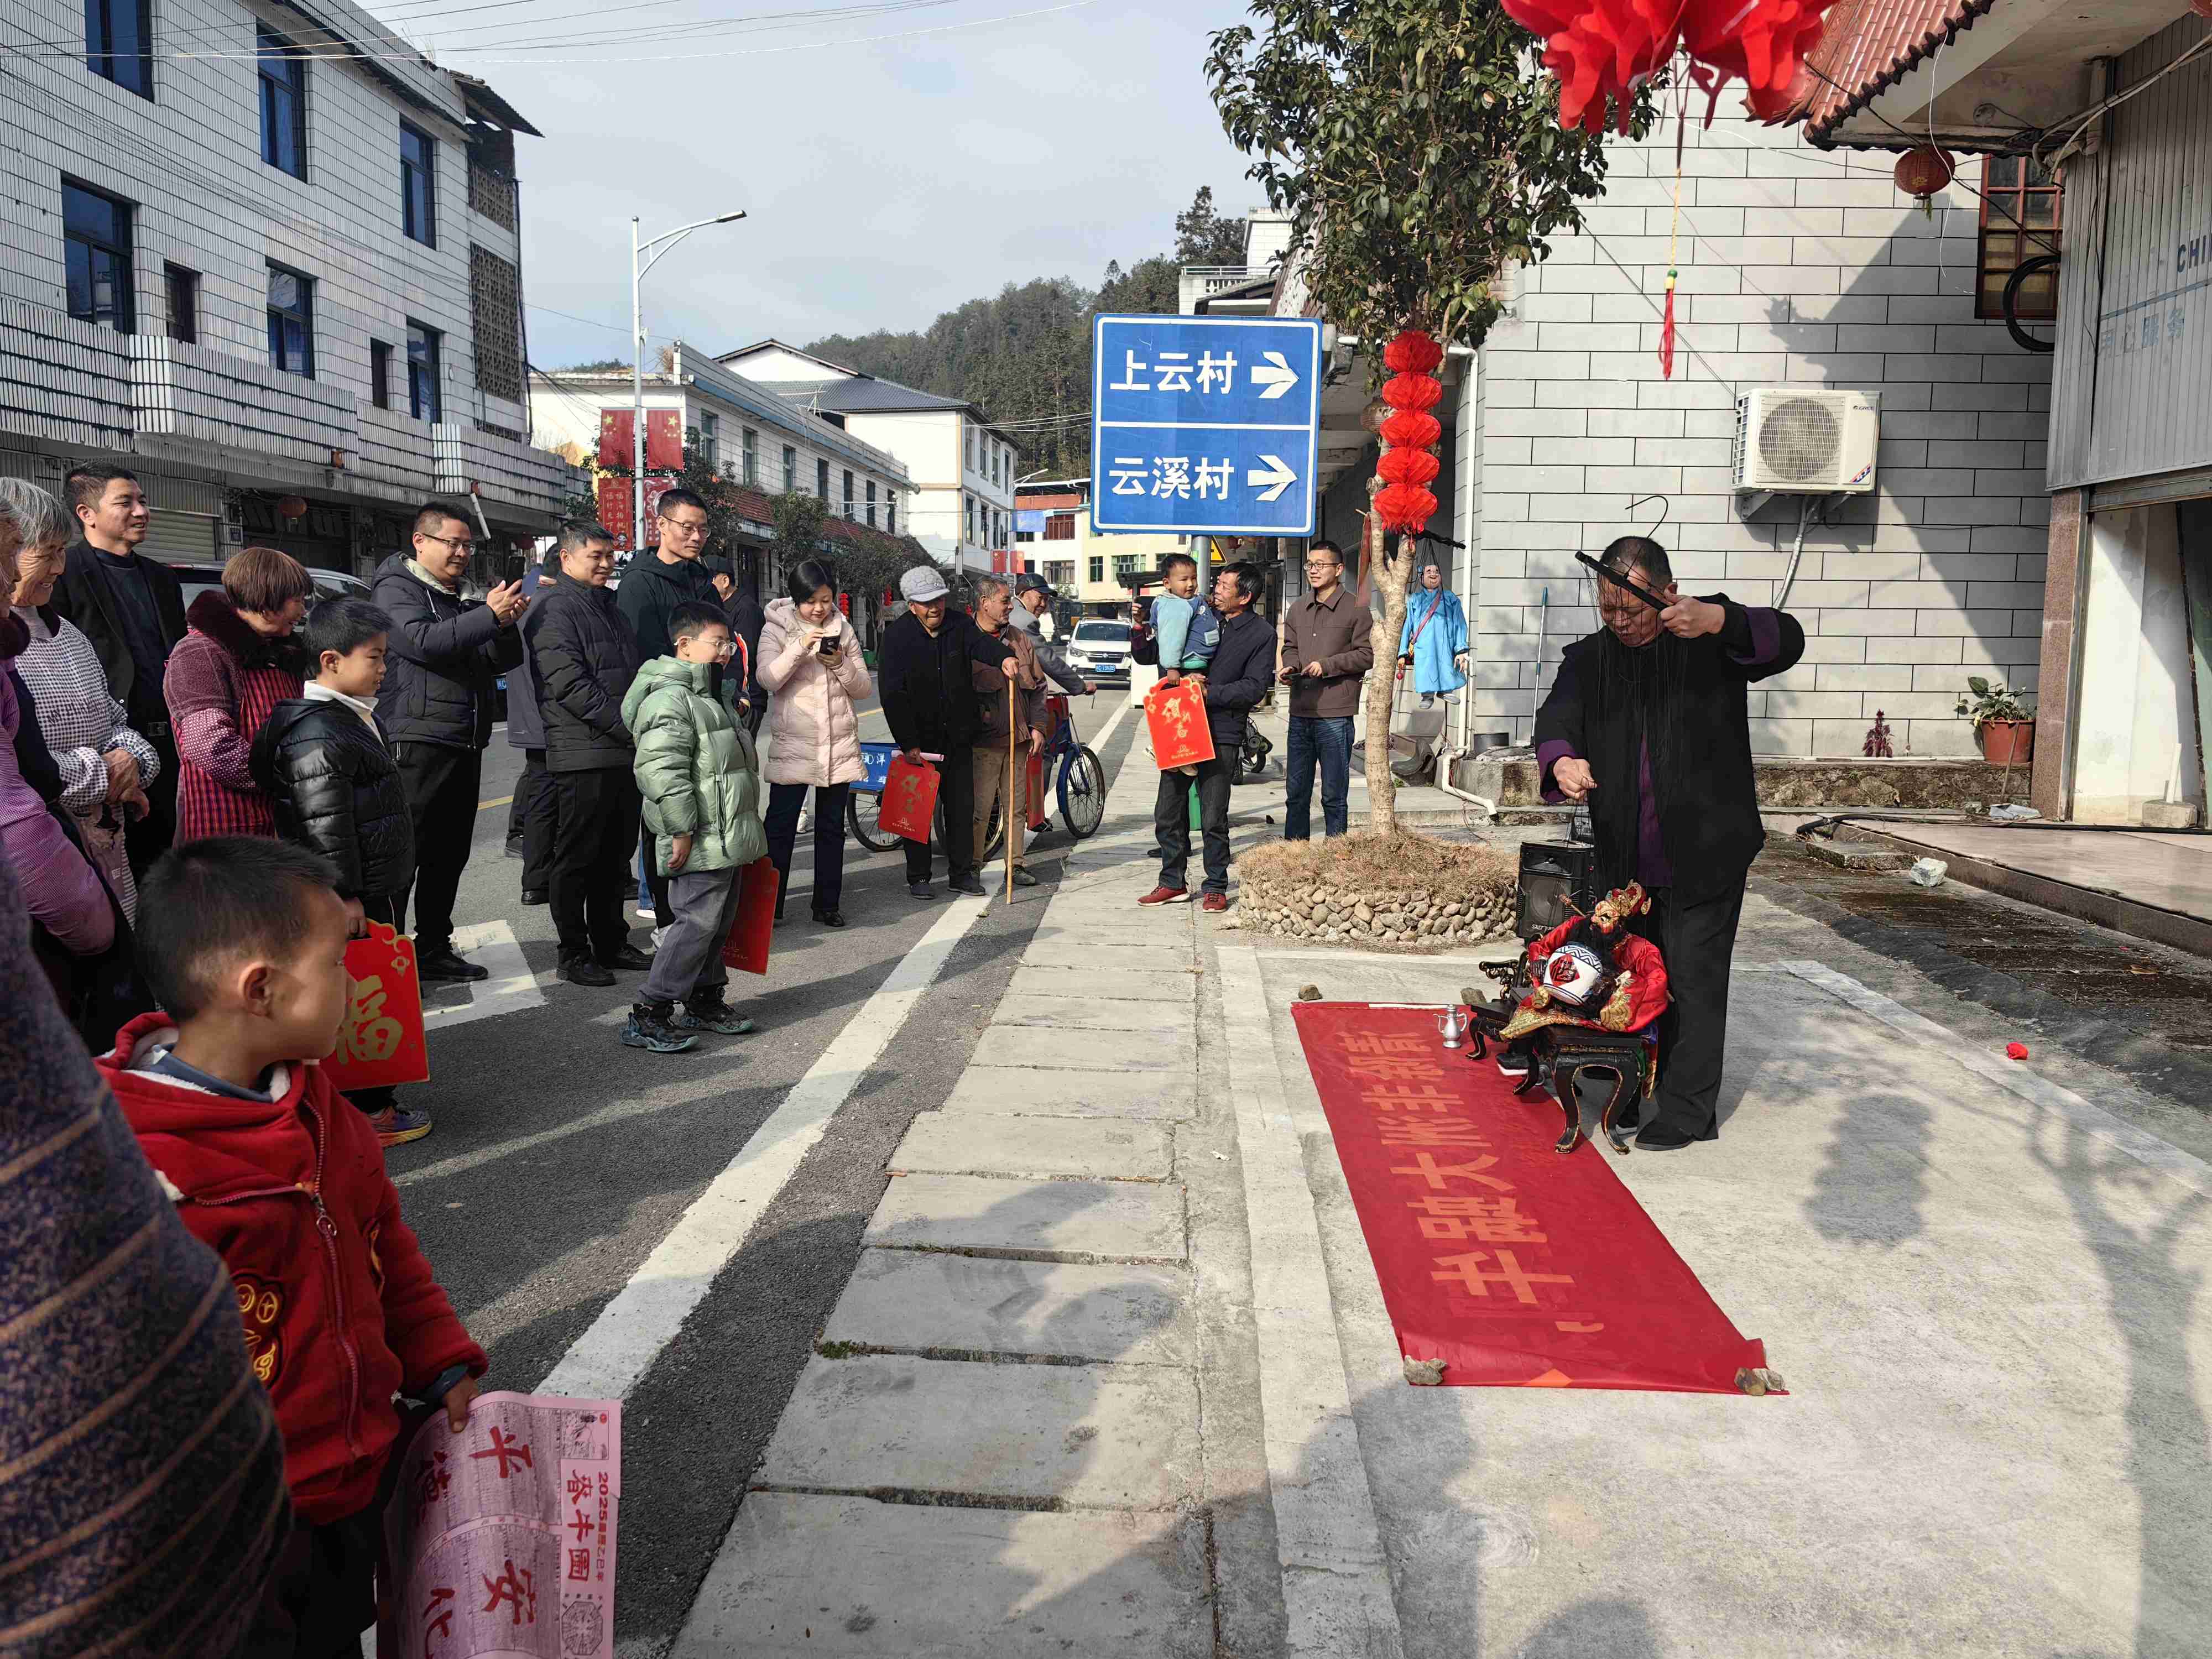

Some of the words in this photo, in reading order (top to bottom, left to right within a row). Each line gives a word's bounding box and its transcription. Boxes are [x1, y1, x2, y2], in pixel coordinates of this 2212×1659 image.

[1110, 349, 1238, 394] 上云村
[1109, 456, 1235, 501] 云溪村
